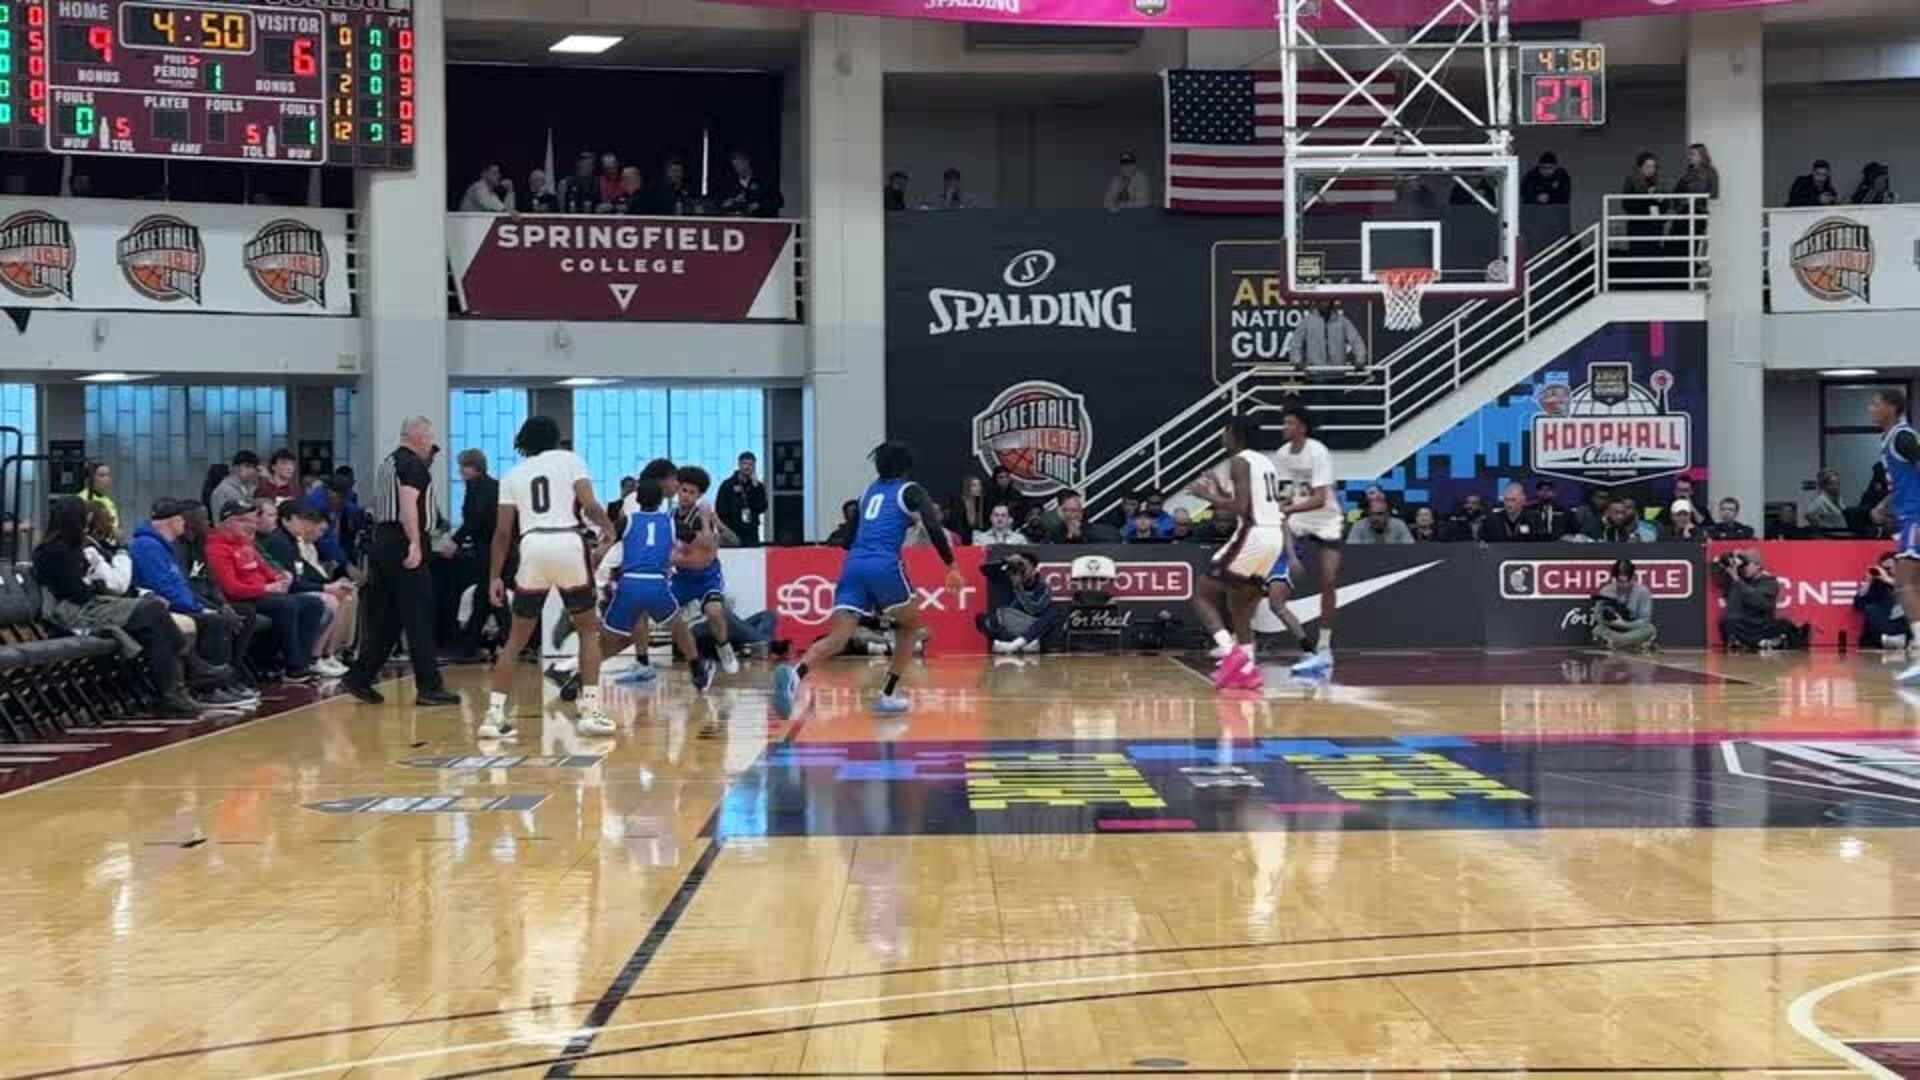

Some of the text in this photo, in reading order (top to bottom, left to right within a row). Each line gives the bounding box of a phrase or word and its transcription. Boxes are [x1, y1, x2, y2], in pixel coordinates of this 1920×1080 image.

[59, 2, 109, 19] HOME
[153, 11, 245, 48] 4:50
[257, 15, 319, 33] VISITOR
[89, 27, 112, 63] 9
[339, 27, 352, 46] 0
[400, 30, 414, 49] 0
[293, 38, 318, 75] 6
[369, 53, 383, 71] 0
[400, 54, 414, 73] 0
[1538, 48, 1601, 72] 4:50
[78, 69, 119, 83] BONUS
[153, 65, 198, 79] PERIOD
[214, 63, 223, 90] 1
[256, 79, 296, 94] BONUS
[339, 74, 414, 96] 2 0 3
[55, 91, 94, 104] FOULS
[144, 96, 189, 109] PLAYER
[206, 99, 243, 112] FOULS
[1536, 78, 1590, 122] 27
[280, 103, 317, 116] FOULS
[400, 101, 414, 120] 0
[75, 106, 94, 136] 0
[308, 119, 317, 145] 1
[334, 121, 352, 141] 12
[400, 125, 414, 144] 3
[111, 139, 135, 153] TOL
[242, 145, 264, 158] TOL
[497, 225, 745, 251] SPRINGFIELD
[560, 258, 685, 273] COLLEGE
[928, 285, 1136, 335] SPALDING
[1231, 309, 1310, 328] NATIO
[1231, 331, 1299, 359] GUA
[983, 399, 1077, 438] BASKETBALL
[1543, 422, 1680, 452] HOOPHALL
[1581, 446, 1639, 465] Classic
[1037, 451, 1079, 486] FAME
[531, 475, 551, 514] 0
[864, 493, 885, 520] 0
[646, 521, 656, 546] 1
[1046, 572, 1182, 591] CHIPOTLE
[1543, 569, 1681, 589] CHIPTLE
[1797, 581, 1867, 605] NE
